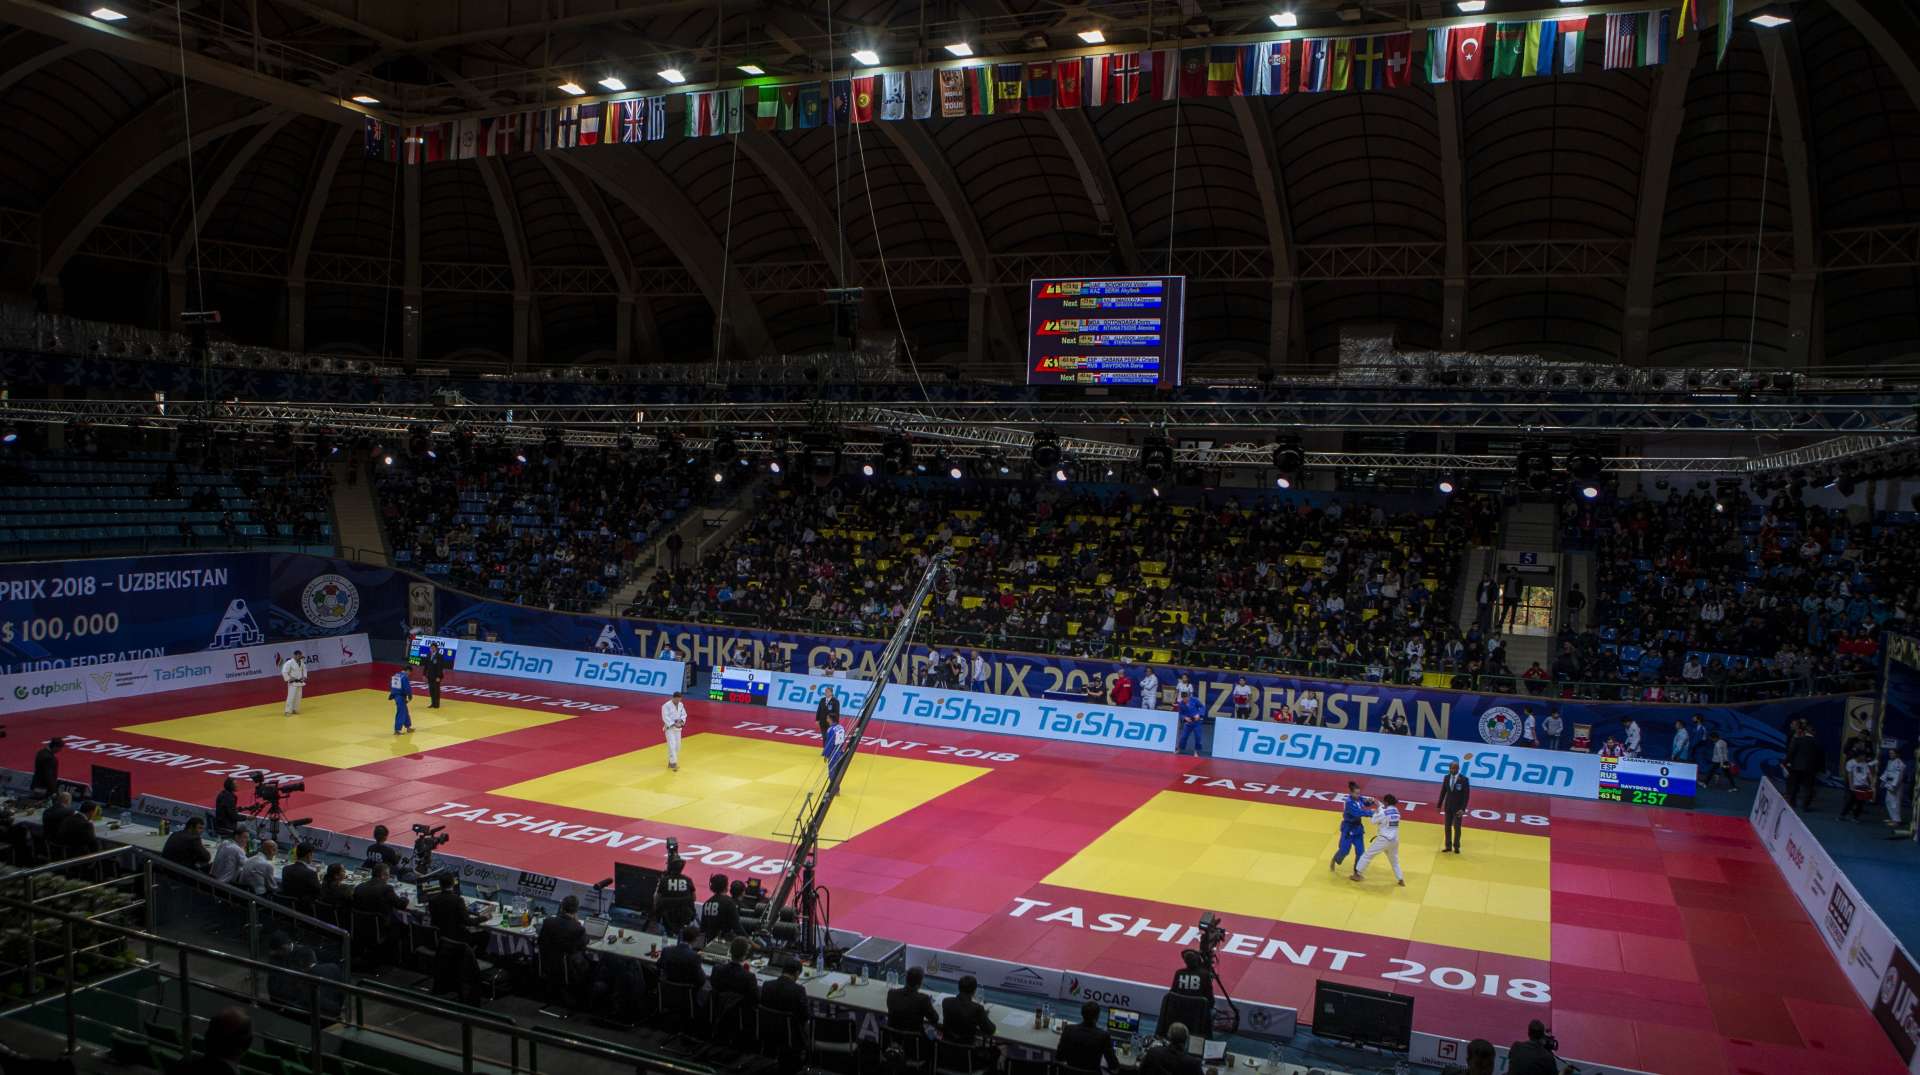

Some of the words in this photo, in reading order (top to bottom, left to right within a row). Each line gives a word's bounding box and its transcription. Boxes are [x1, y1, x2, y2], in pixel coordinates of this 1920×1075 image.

[1063, 299, 1077, 307] Next
[1062, 337, 1077, 345] Next
[1060, 374, 1075, 382] Next
[0, 579, 46, 600] PRIX
[51, 576, 96, 598] 2018
[118, 568, 228, 592] UZBEKISTAN
[22, 612, 119, 641] 100,000
[412, 616, 432, 626] JUDO
[468, 646, 554, 674] TaiShan
[153, 664, 212, 681] TaiShan
[574, 657, 667, 687] TaiShan
[32, 679, 82, 698] otpbank
[902, 692, 1021, 727] TaiShan
[1038, 706, 1167, 742] TaiShan
[927, 745, 1020, 761] 2018
[1237, 726, 1381, 767] TaiShan
[1417, 745, 1574, 787] TaiShan
[1660, 767, 1669, 776] 0
[1659, 778, 1669, 788] 0
[1612, 793, 1621, 801] kg
[1632, 791, 1668, 805] 2:57
[144, 804, 168, 817] SOCAR
[425, 802, 678, 853] TASHKENT
[367, 851, 383, 863] HB
[668, 878, 688, 892] HB
[704, 902, 719, 916] HB
[1178, 974, 1201, 990] HB
[1381, 958, 1552, 1003] 2018
[1083, 988, 1130, 1006] SOCAR
